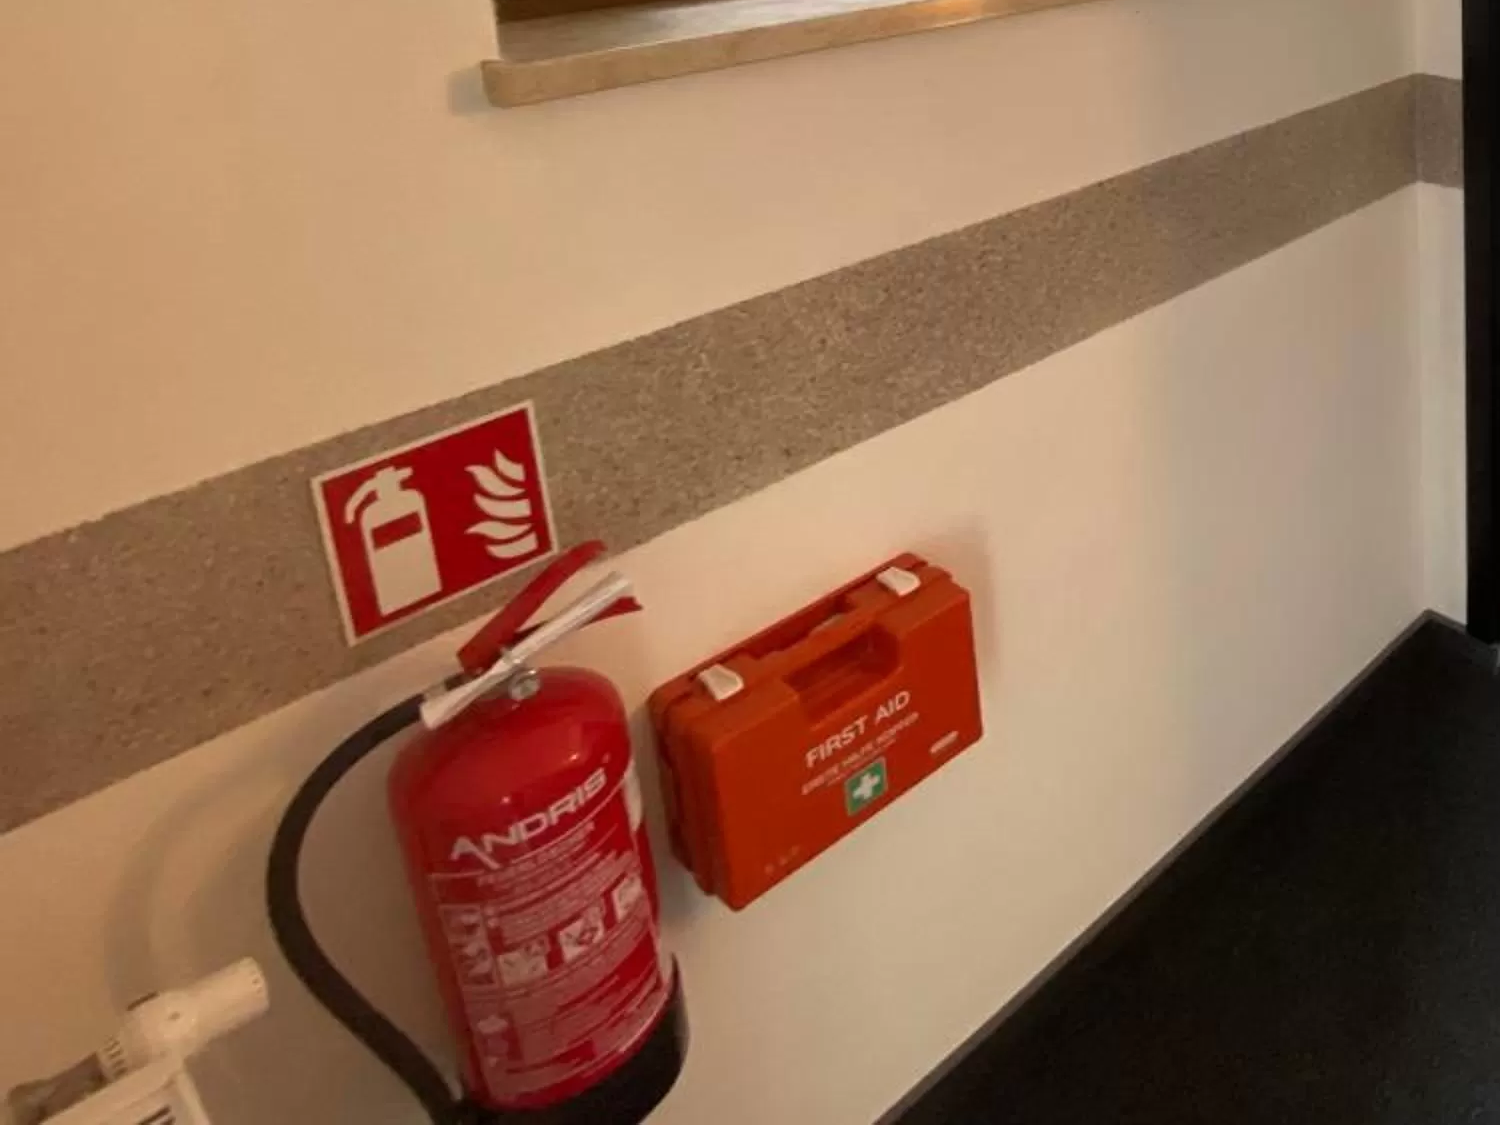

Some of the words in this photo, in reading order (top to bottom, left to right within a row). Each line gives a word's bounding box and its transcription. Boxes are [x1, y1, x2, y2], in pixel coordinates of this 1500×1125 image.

[805, 715, 868, 768] FIRST
[875, 691, 911, 725] AID
[451, 767, 607, 870] ANDRIS
